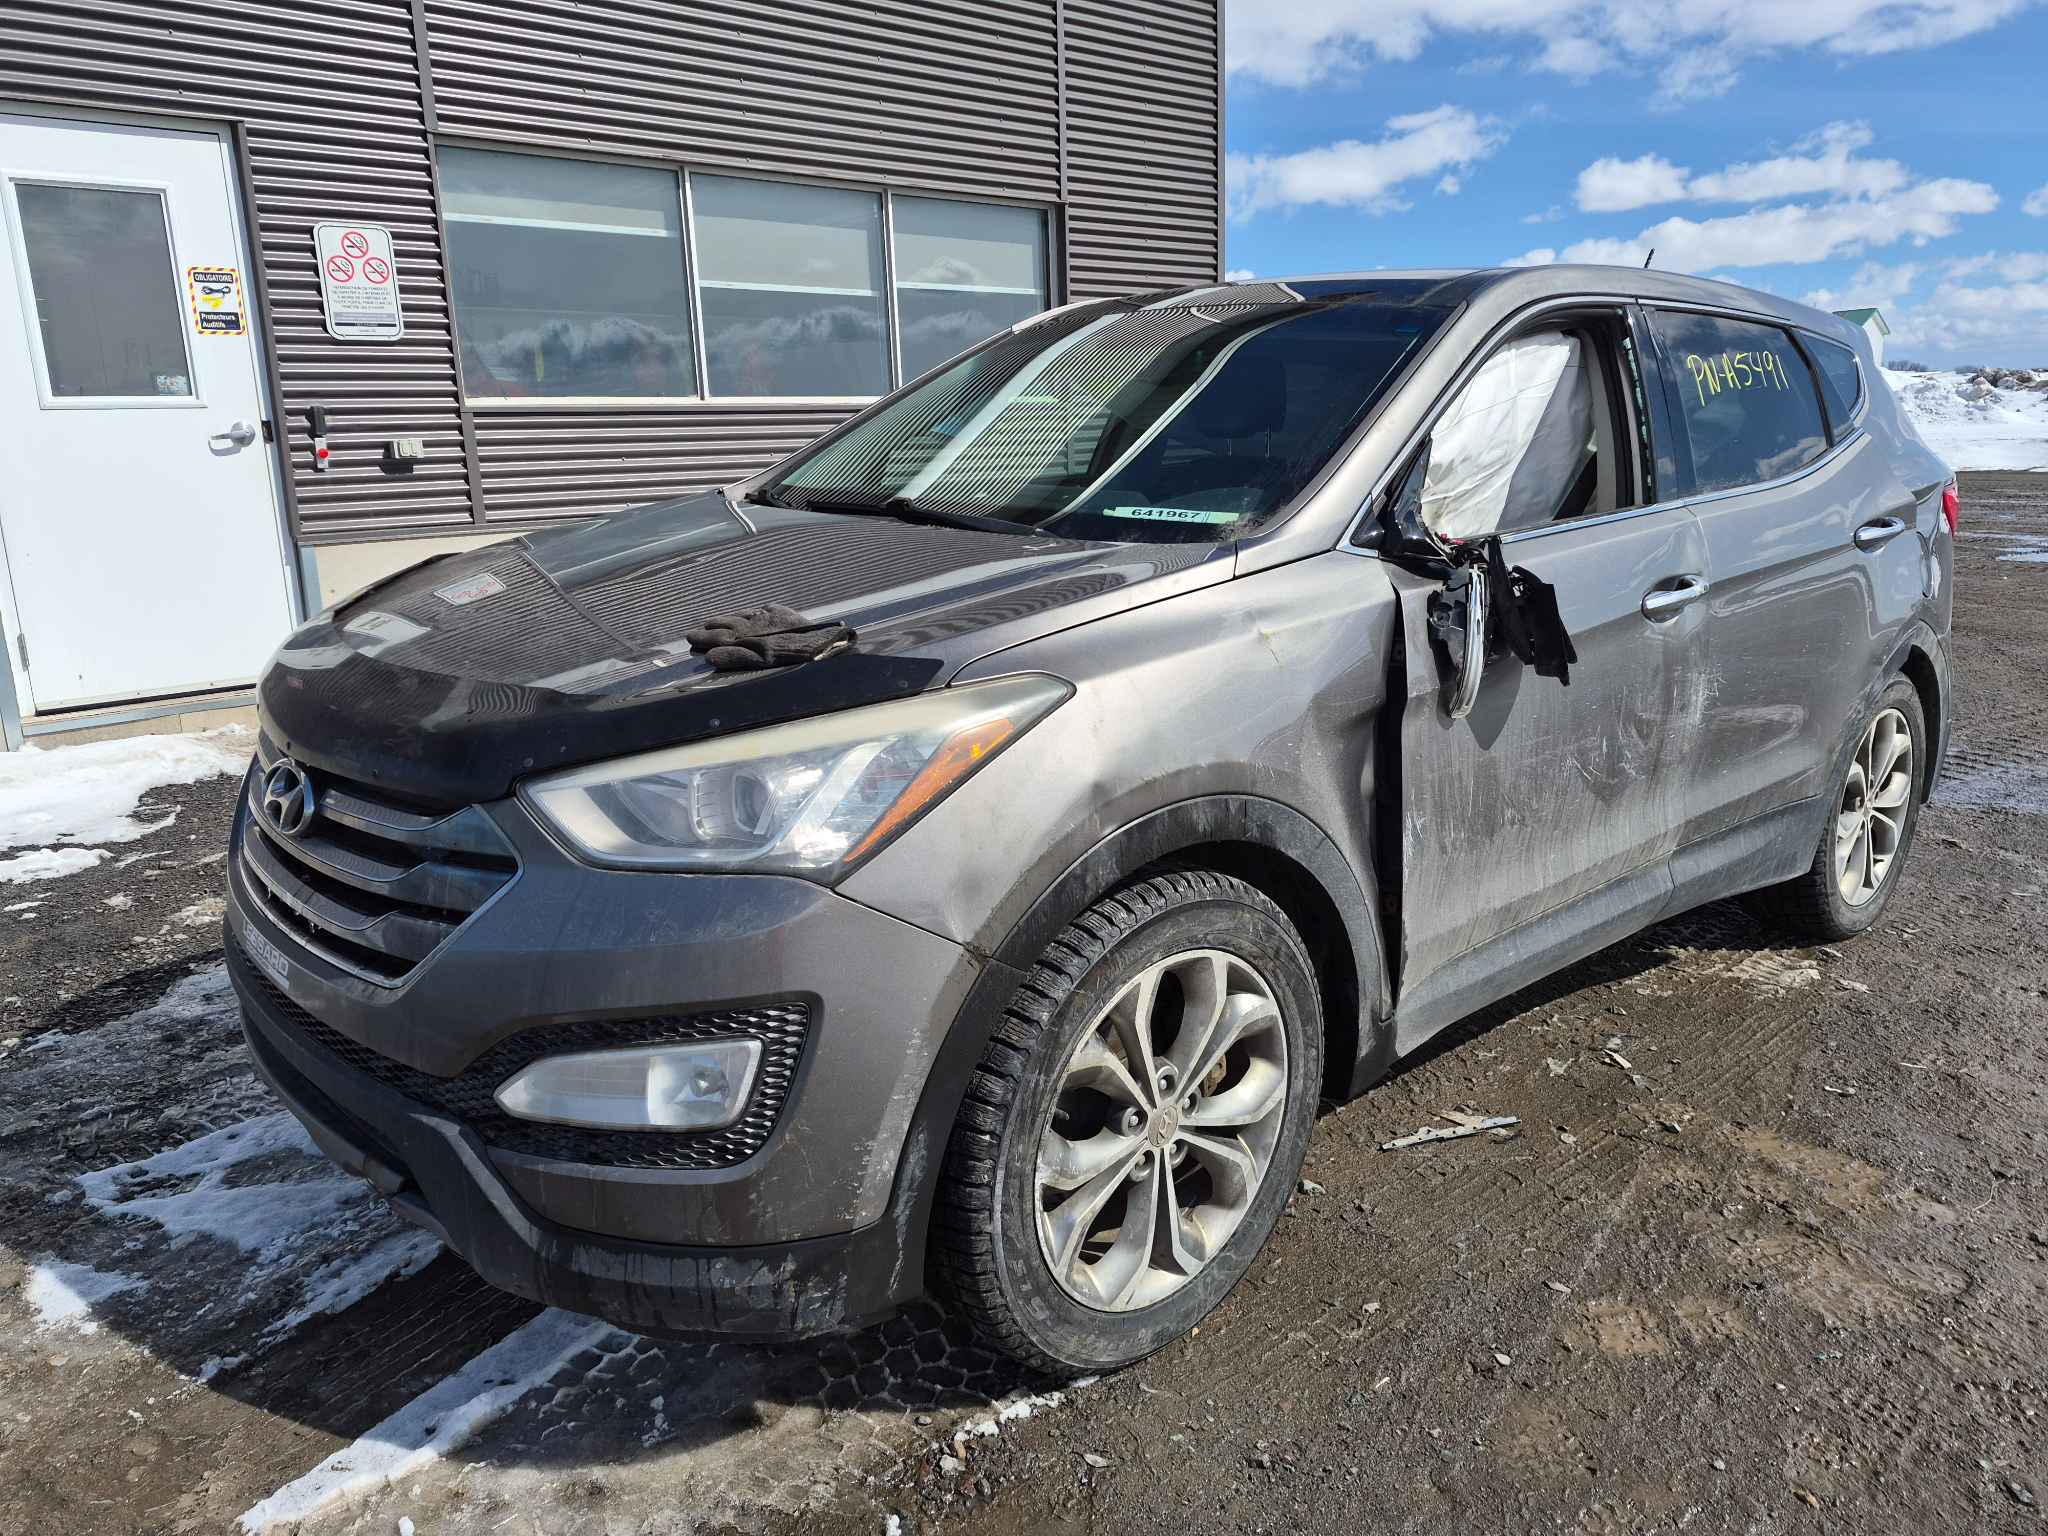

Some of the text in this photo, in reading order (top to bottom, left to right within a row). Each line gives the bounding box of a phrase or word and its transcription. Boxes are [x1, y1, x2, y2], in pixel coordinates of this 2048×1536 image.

[194, 273, 233, 282] OBLIGATOIRE
[201, 313, 235, 321] Protecteurs
[1131, 508, 1201, 519] 641967
